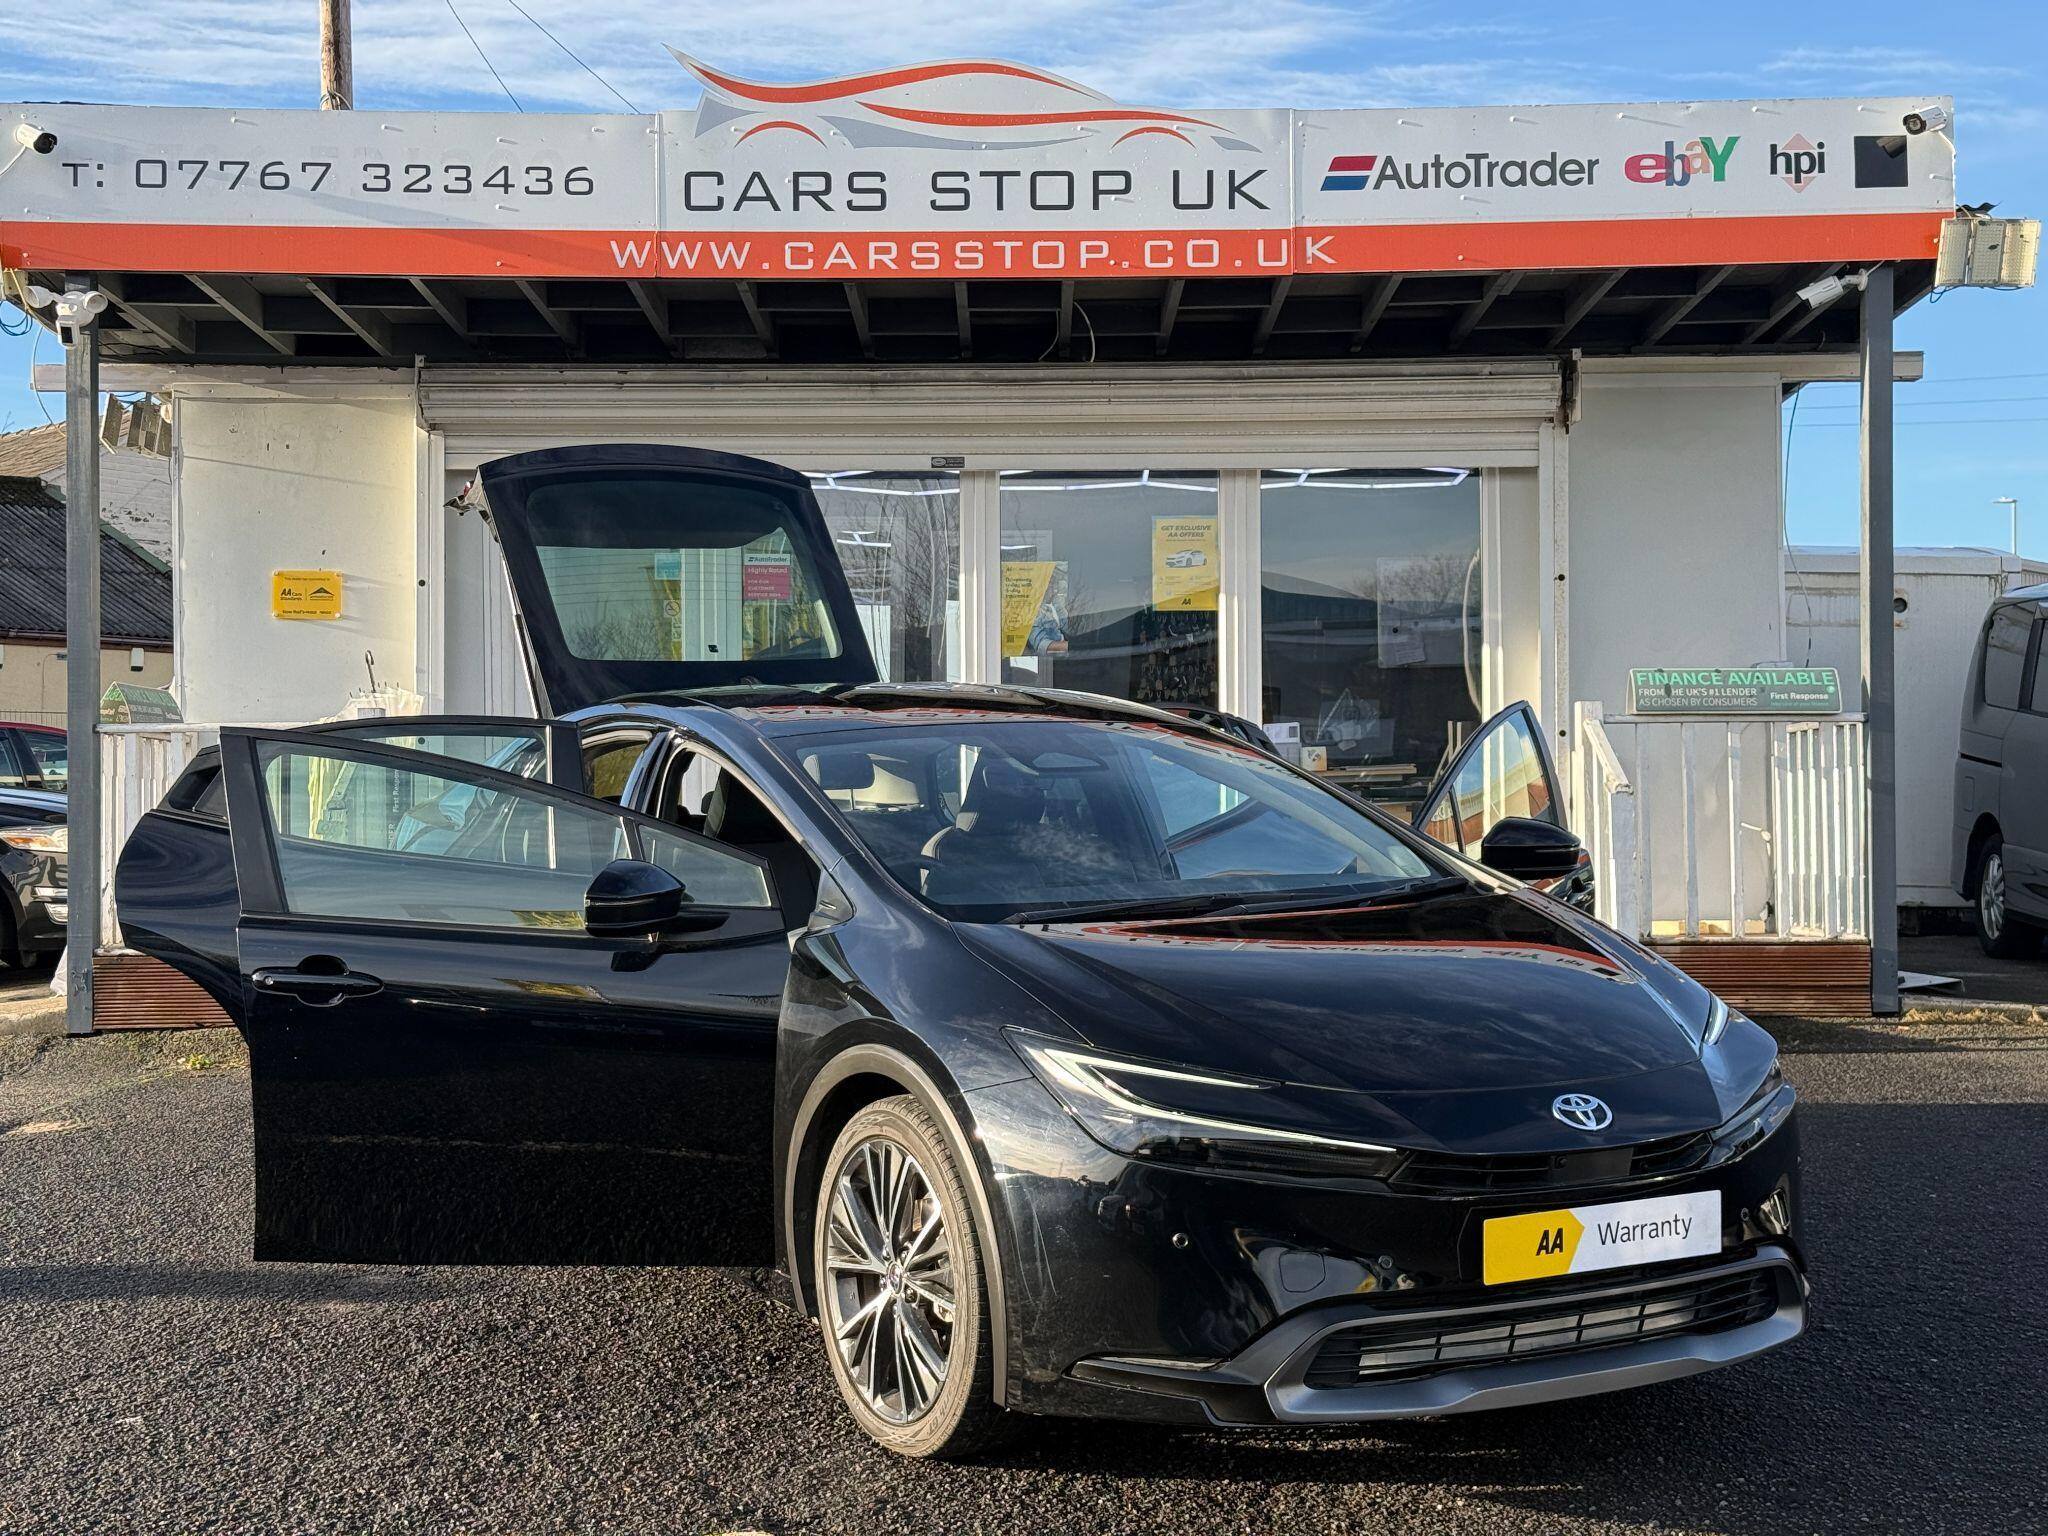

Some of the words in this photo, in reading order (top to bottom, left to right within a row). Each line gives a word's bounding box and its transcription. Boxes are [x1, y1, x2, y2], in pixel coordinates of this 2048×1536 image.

[61, 162, 104, 188] T:
[135, 159, 332, 192] 07767
[362, 163, 594, 196] 323436
[1375, 151, 1600, 190] AutoTrader
[1769, 141, 1826, 184] hpi
[684, 171, 887, 212] CARS
[930, 170, 1132, 212] STOP
[1172, 169, 1270, 210] UK
[610, 235, 1338, 272] WWW.CARSSTOP.CO.UK
[280, 588, 292, 597] AA
[1636, 671, 1724, 686] FINANCE
[1728, 671, 1835, 686] AVAILABLE
[1638, 688, 1665, 697] FROM
[1686, 687, 1708, 697] UK'S
[1721, 687, 1758, 697] LENDER
[1770, 691, 1789, 700] First
[1790, 691, 1829, 701] Response
[1639, 698, 1651, 707] AS
[1652, 697, 1689, 707] CHOSEN
[1690, 698, 1701, 707] BY
[1702, 697, 1758, 707] CONSUMERS
[1535, 1227, 1564, 1257] AA
[1597, 1213, 1693, 1246] Warranty
